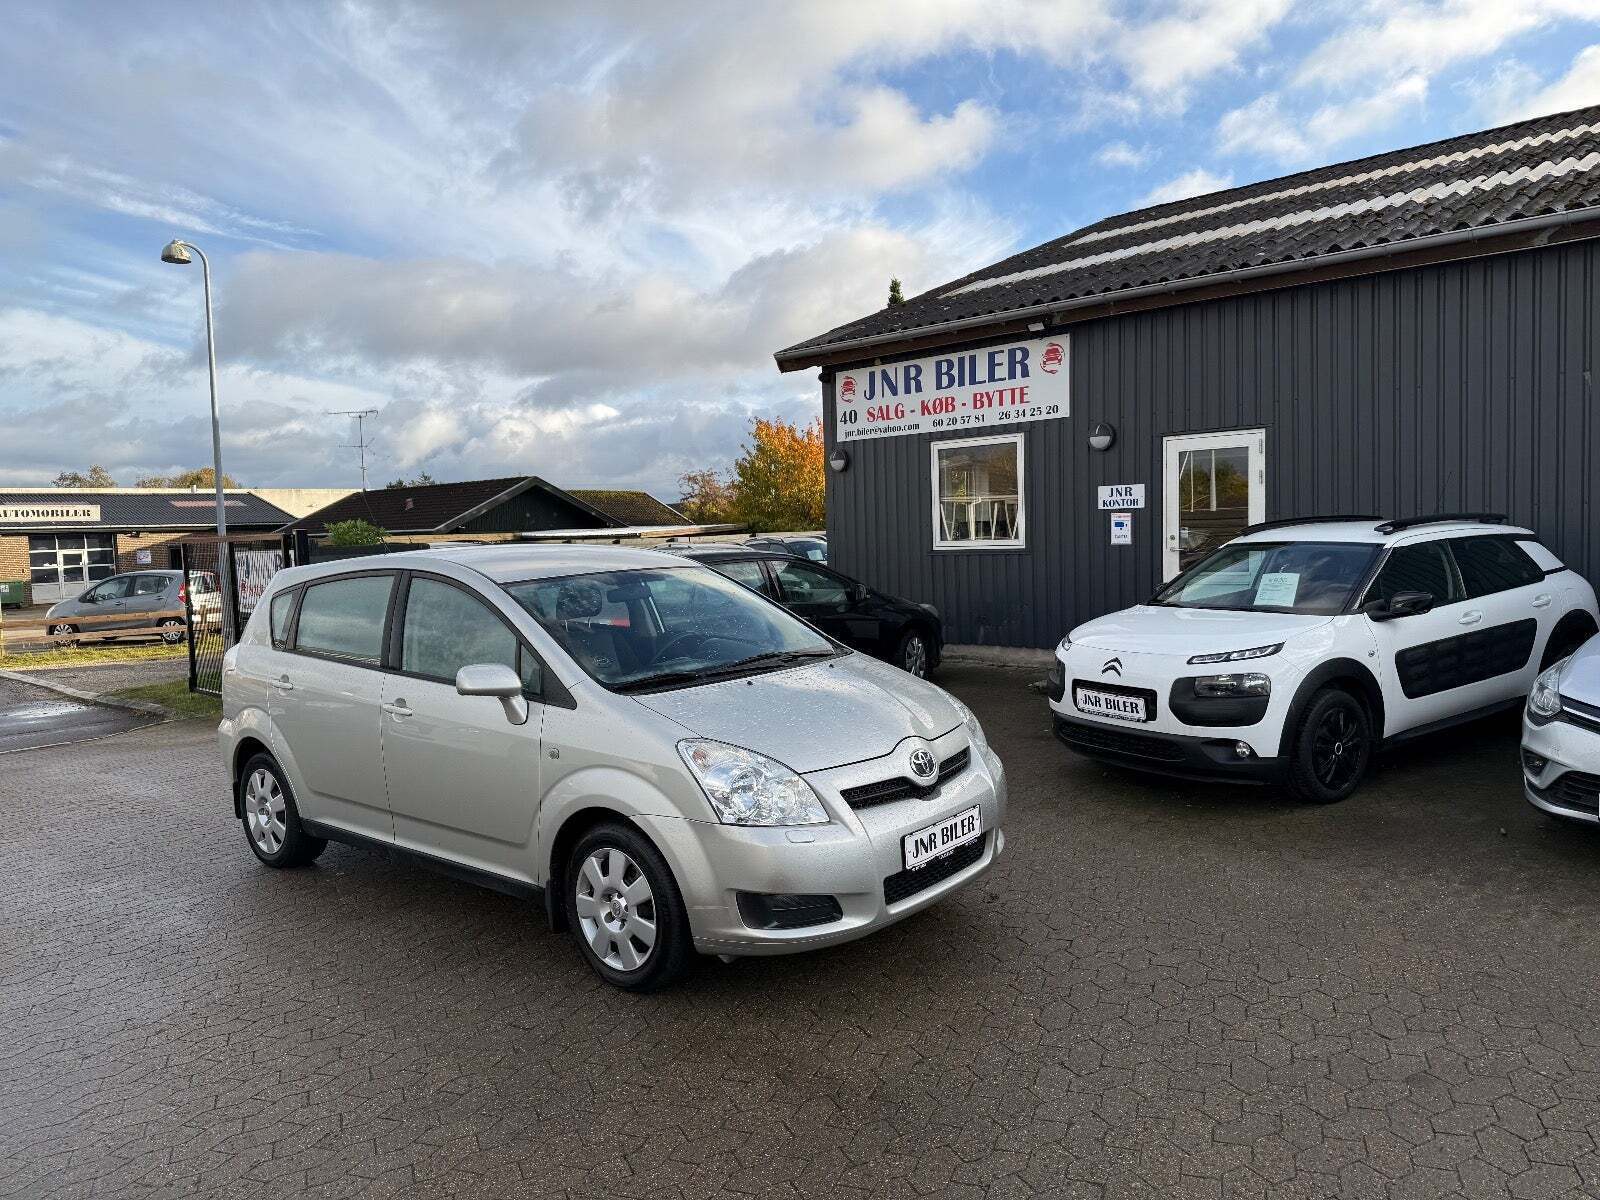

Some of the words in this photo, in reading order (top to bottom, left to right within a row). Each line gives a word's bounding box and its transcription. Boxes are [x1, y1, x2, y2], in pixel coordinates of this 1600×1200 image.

[864, 364, 923, 401] JNR
[935, 346, 1030, 391] BILER
[866, 402, 905, 423] SALG
[920, 396, 956, 416] KØB
[972, 385, 1031, 410] BYTTE
[998, 410, 1011, 420] 26
[1013, 408, 1026, 419] 34
[1029, 406, 1042, 417] 25
[1045, 404, 1059, 415] 20
[840, 409, 858, 425] 40
[932, 418, 944, 428] 60
[946, 416, 958, 426] 20
[960, 415, 971, 425] 57
[974, 413, 985, 423] 81
[844, 423, 920, 440] jnr.biler@yahoo.com
[1109, 486, 1133, 498] JNR
[1082, 693, 1102, 708] JNR
[1104, 697, 1140, 714] BILER
[912, 832, 938, 859] JNR
[940, 814, 976, 846] BILER
